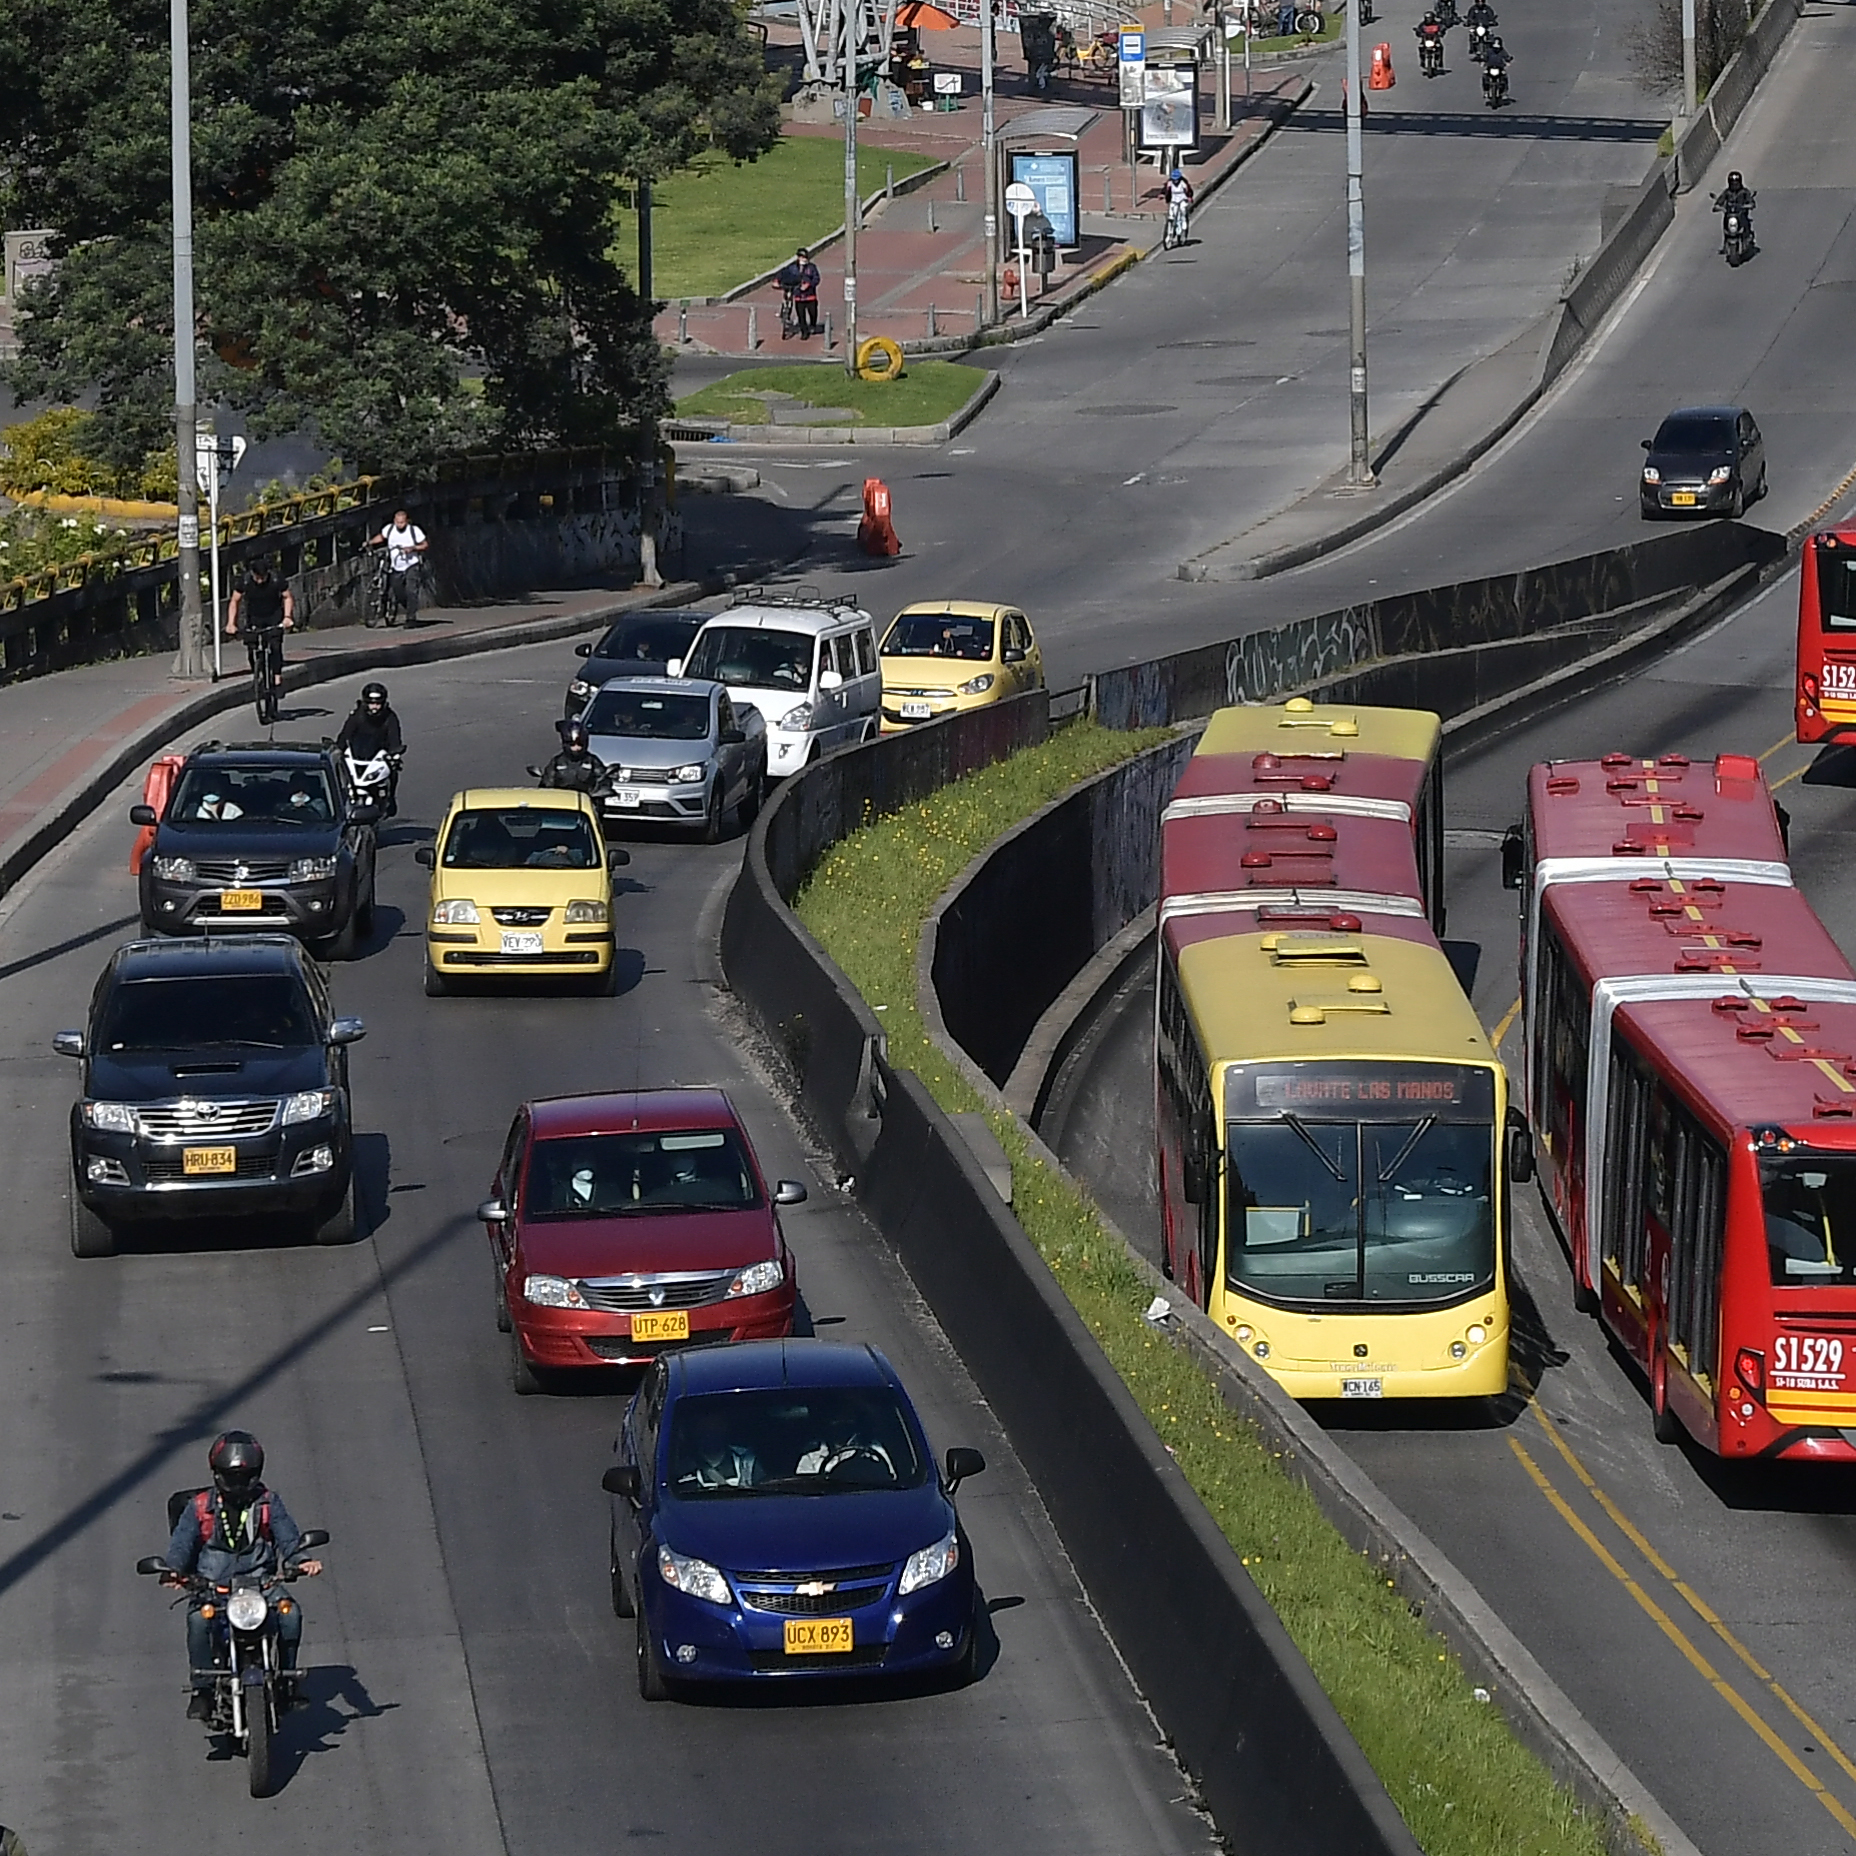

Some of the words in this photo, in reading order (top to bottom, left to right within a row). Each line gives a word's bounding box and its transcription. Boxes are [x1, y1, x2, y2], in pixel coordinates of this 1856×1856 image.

[1358, 1081, 1391, 1100] LAS
[1397, 1081, 1455, 1100] MANOS
[1408, 1273, 1476, 1284] BUSSCAR
[1774, 1337, 1843, 1372] S1529
